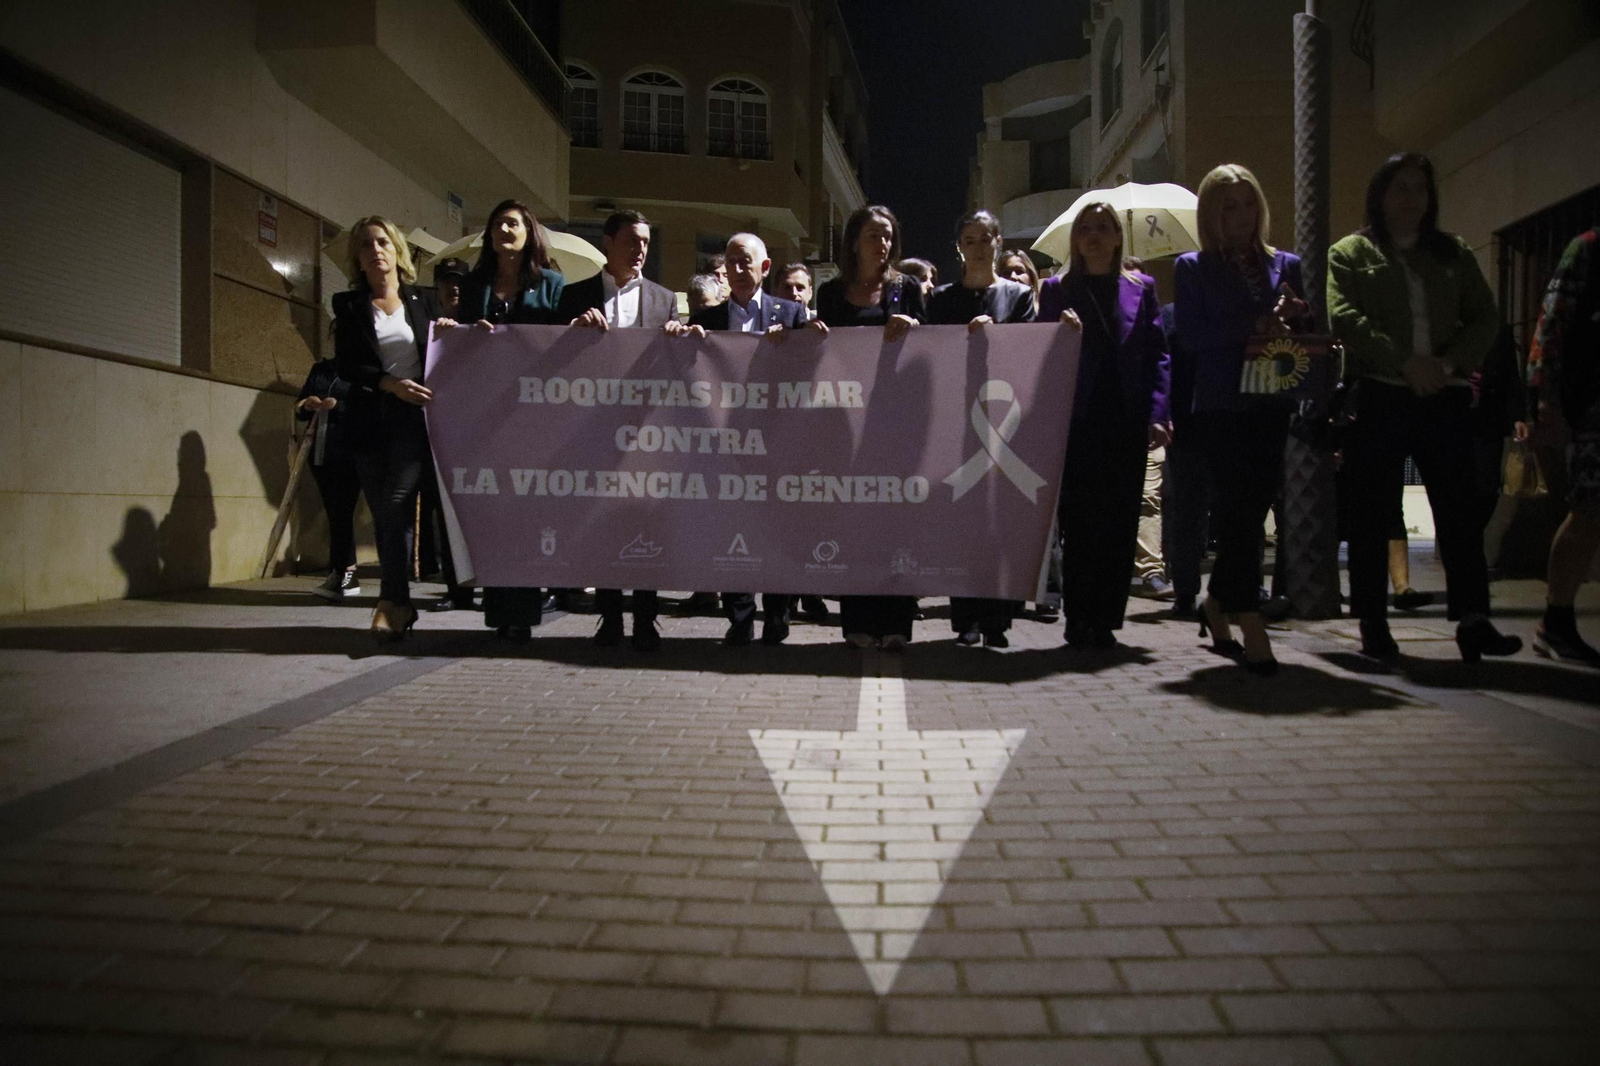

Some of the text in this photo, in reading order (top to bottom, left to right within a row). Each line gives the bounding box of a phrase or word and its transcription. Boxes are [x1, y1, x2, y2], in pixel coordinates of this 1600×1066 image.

[518, 376, 864, 410] ROQUETAS DE MAR
[615, 425, 767, 456] CONTRA
[451, 467, 930, 504] LA VIOLENCIA DE GÉNERO
